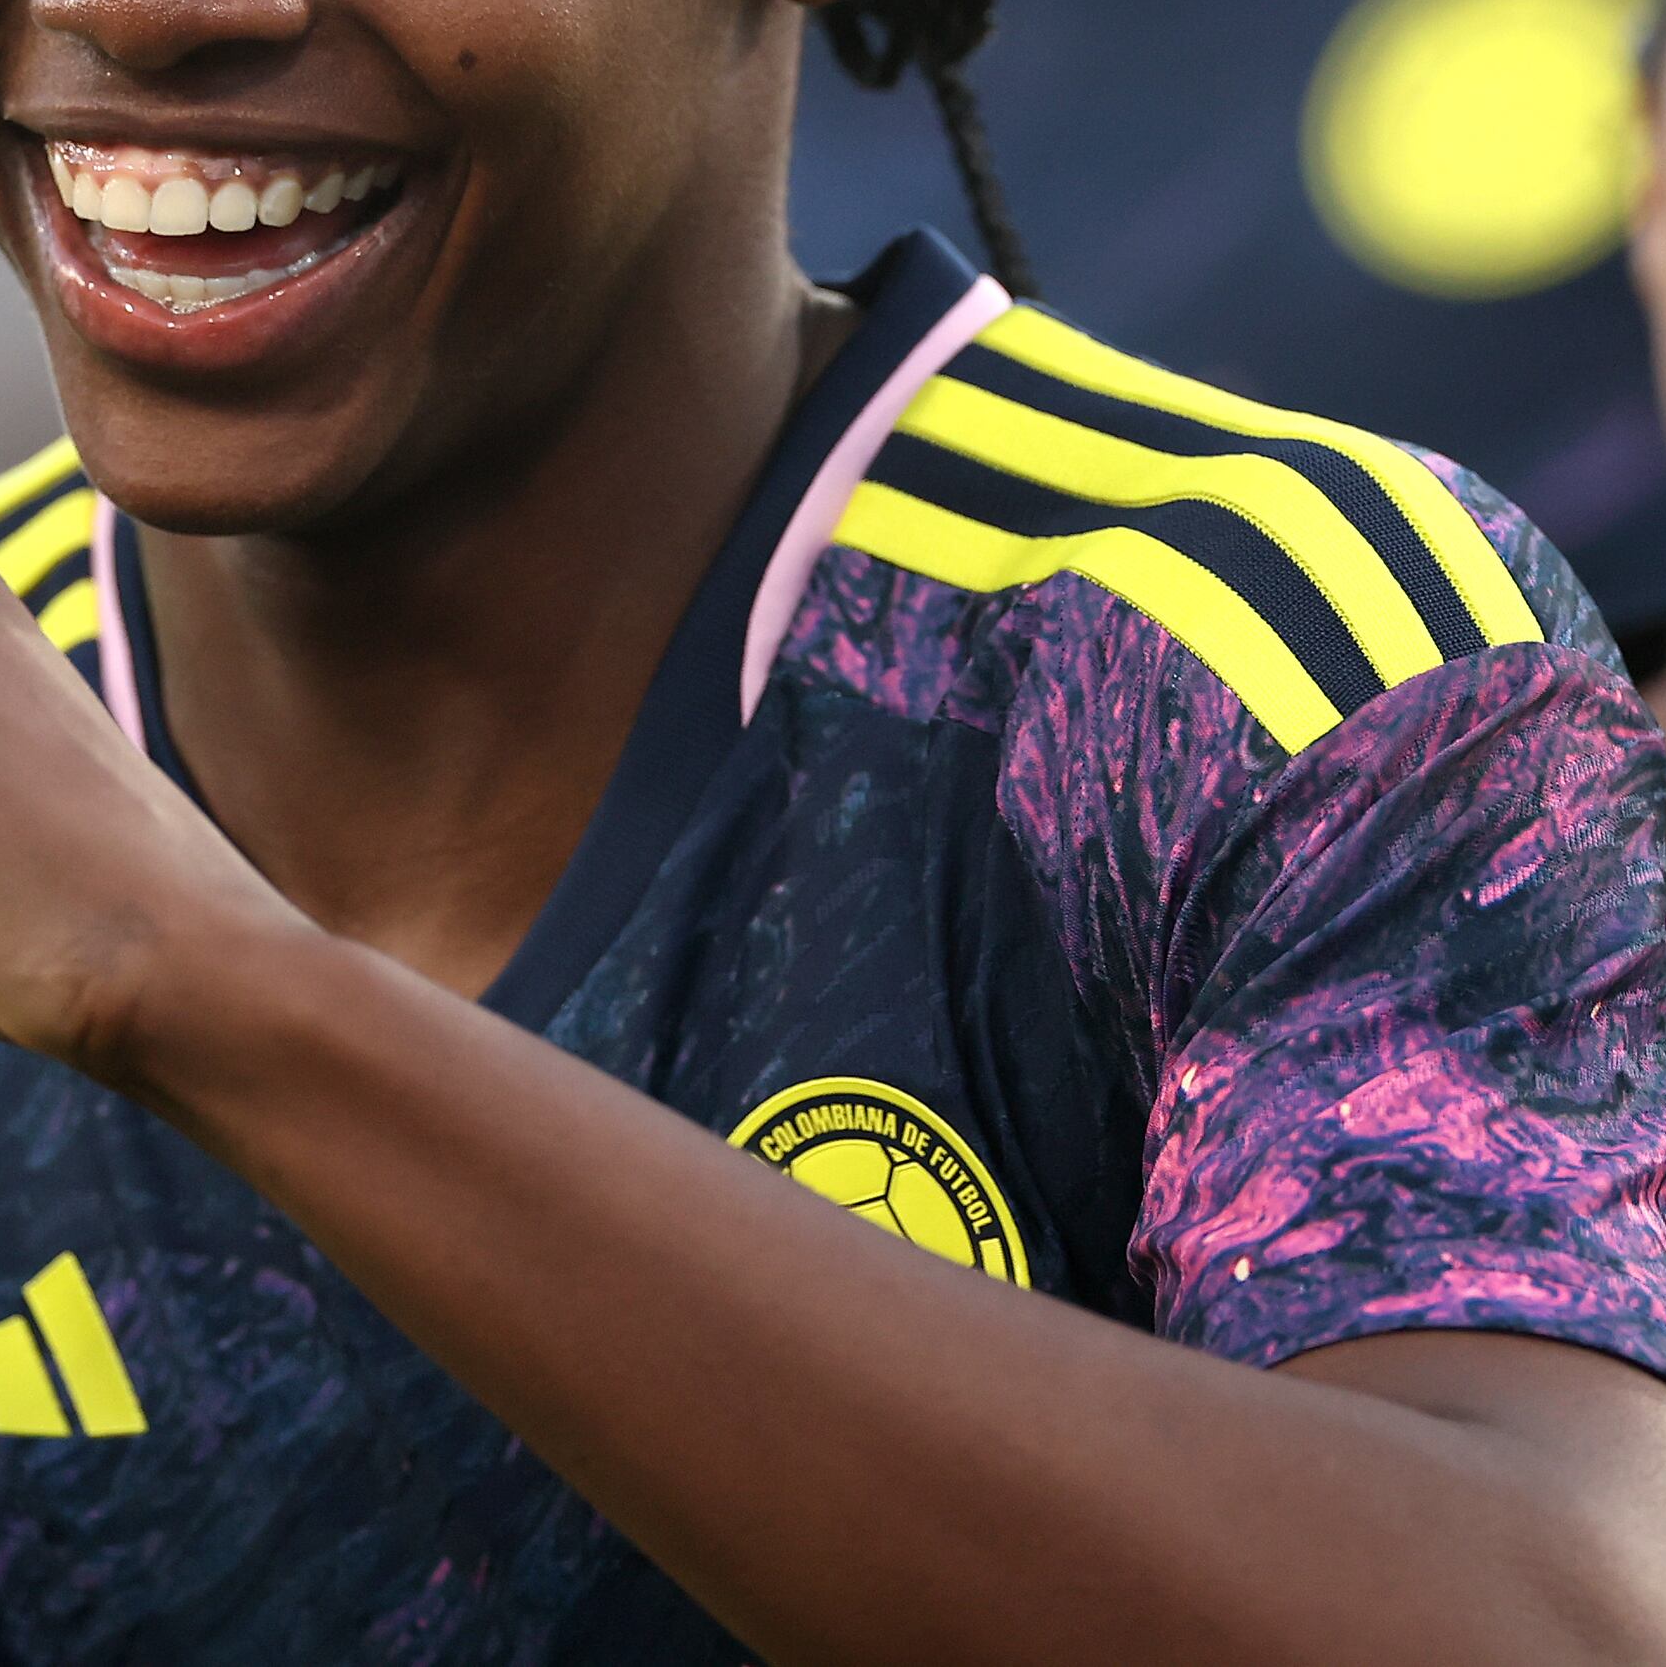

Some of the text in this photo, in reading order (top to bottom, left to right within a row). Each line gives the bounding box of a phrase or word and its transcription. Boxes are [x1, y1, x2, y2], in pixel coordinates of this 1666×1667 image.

[759, 1103, 993, 1234] COLOMBIANA DE FUTBOL
